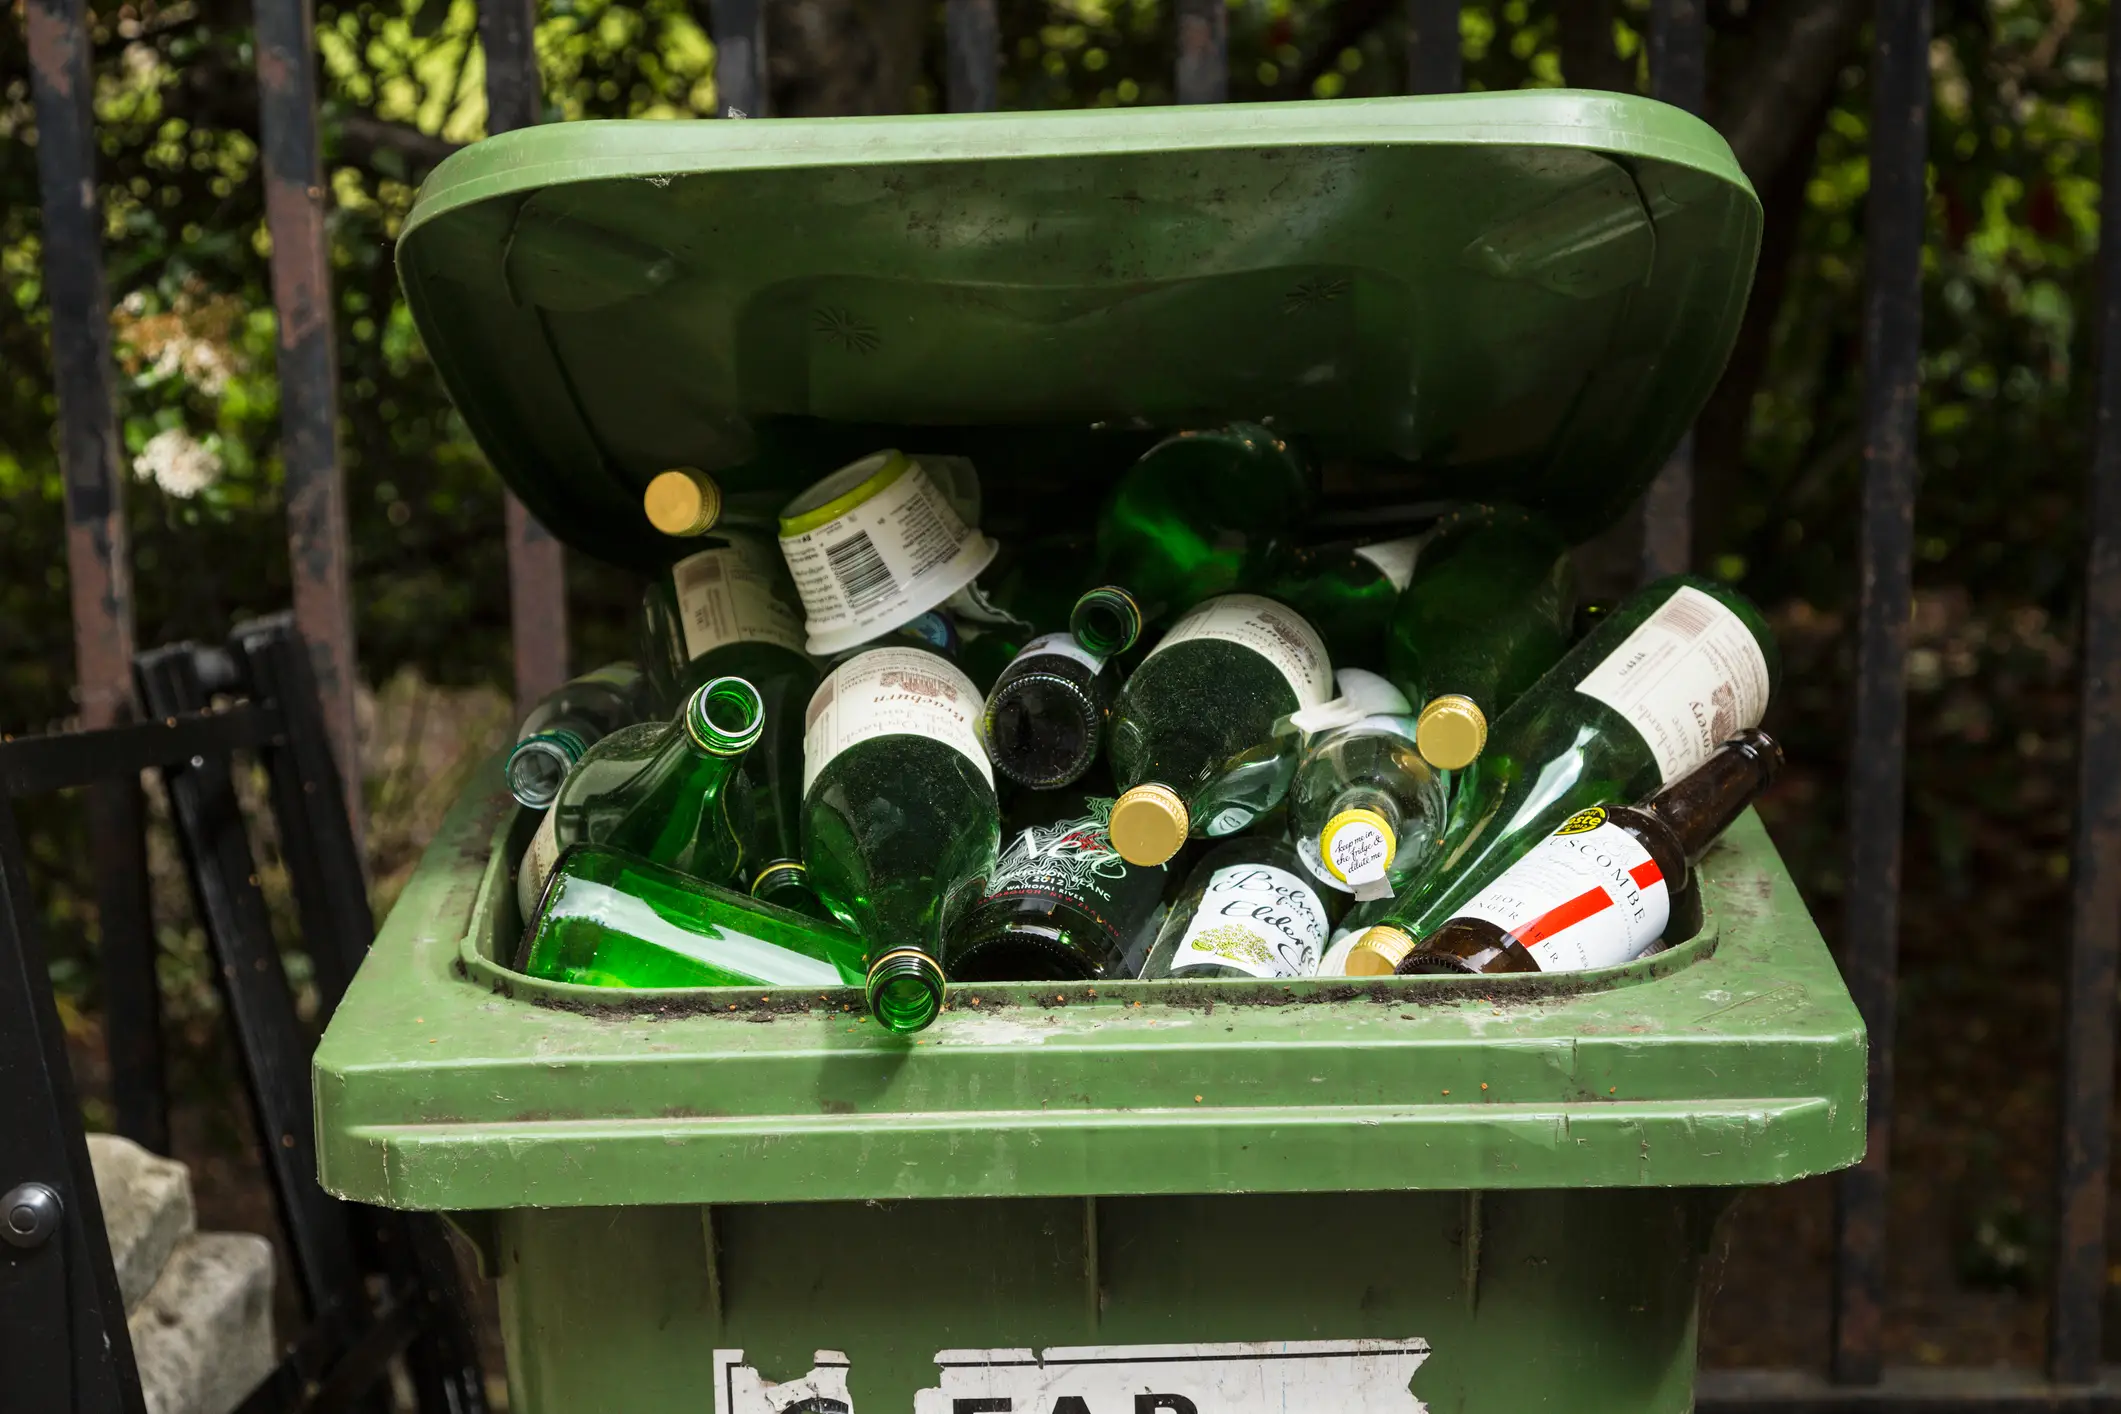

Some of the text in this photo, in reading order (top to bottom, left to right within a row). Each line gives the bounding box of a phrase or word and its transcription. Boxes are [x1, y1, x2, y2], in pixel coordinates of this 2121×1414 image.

[873, 693, 965, 723] Braeburn
[1637, 703, 1680, 777] Orchards
[1688, 701, 1713, 759] covery
[1335, 830, 1375, 854] keep me in
[1336, 834, 1385, 866] the fridge &
[1348, 851, 1383, 874] dilute me
[1031, 875, 1065, 886] 2012
[1549, 836, 1647, 924] USCOMBE
[1006, 883, 1085, 903] WAIHOPAI RIVER
[1049, 891, 1074, 903] NEW
[1490, 894, 1526, 908] HOT
